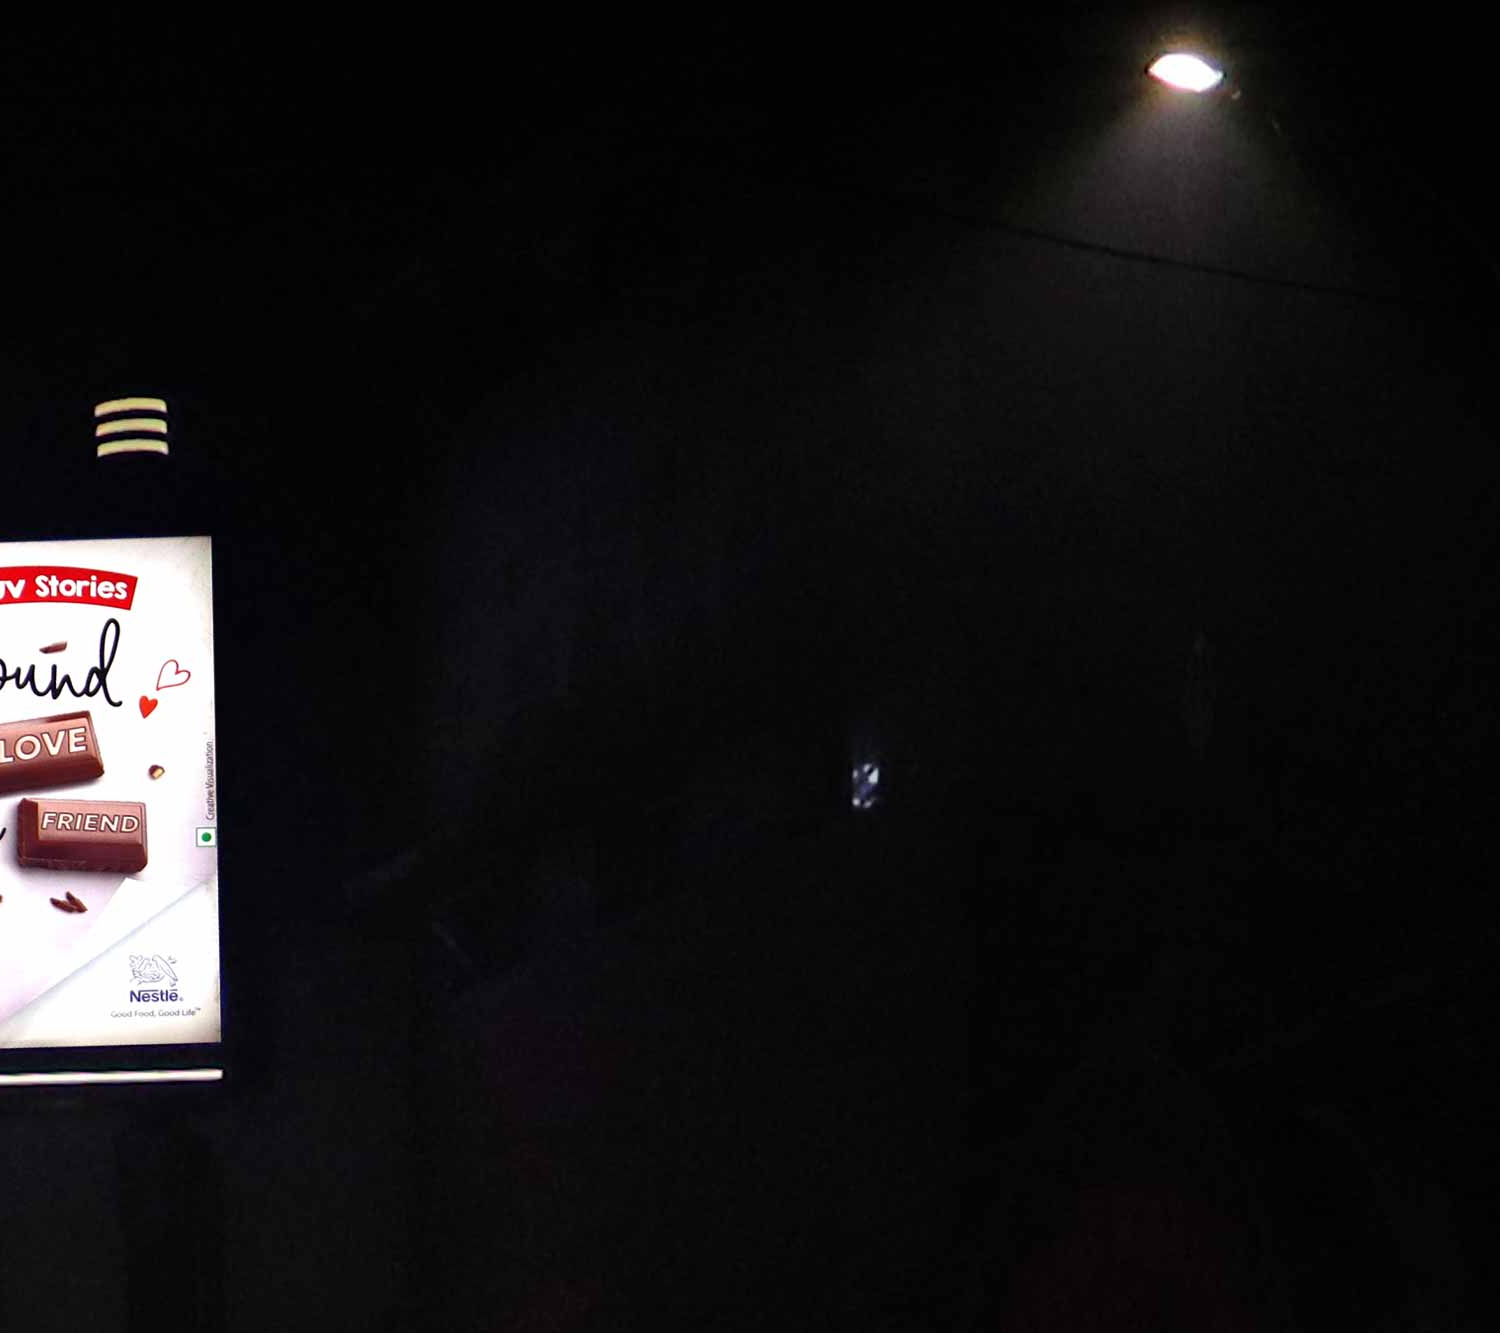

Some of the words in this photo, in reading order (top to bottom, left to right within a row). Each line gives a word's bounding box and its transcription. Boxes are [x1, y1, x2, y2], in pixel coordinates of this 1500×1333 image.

[35, 574, 128, 601] Stories
[40, 812, 140, 833] FRIEND
[110, 1009, 132, 1018] Good
[158, 1008, 180, 1017] Good
